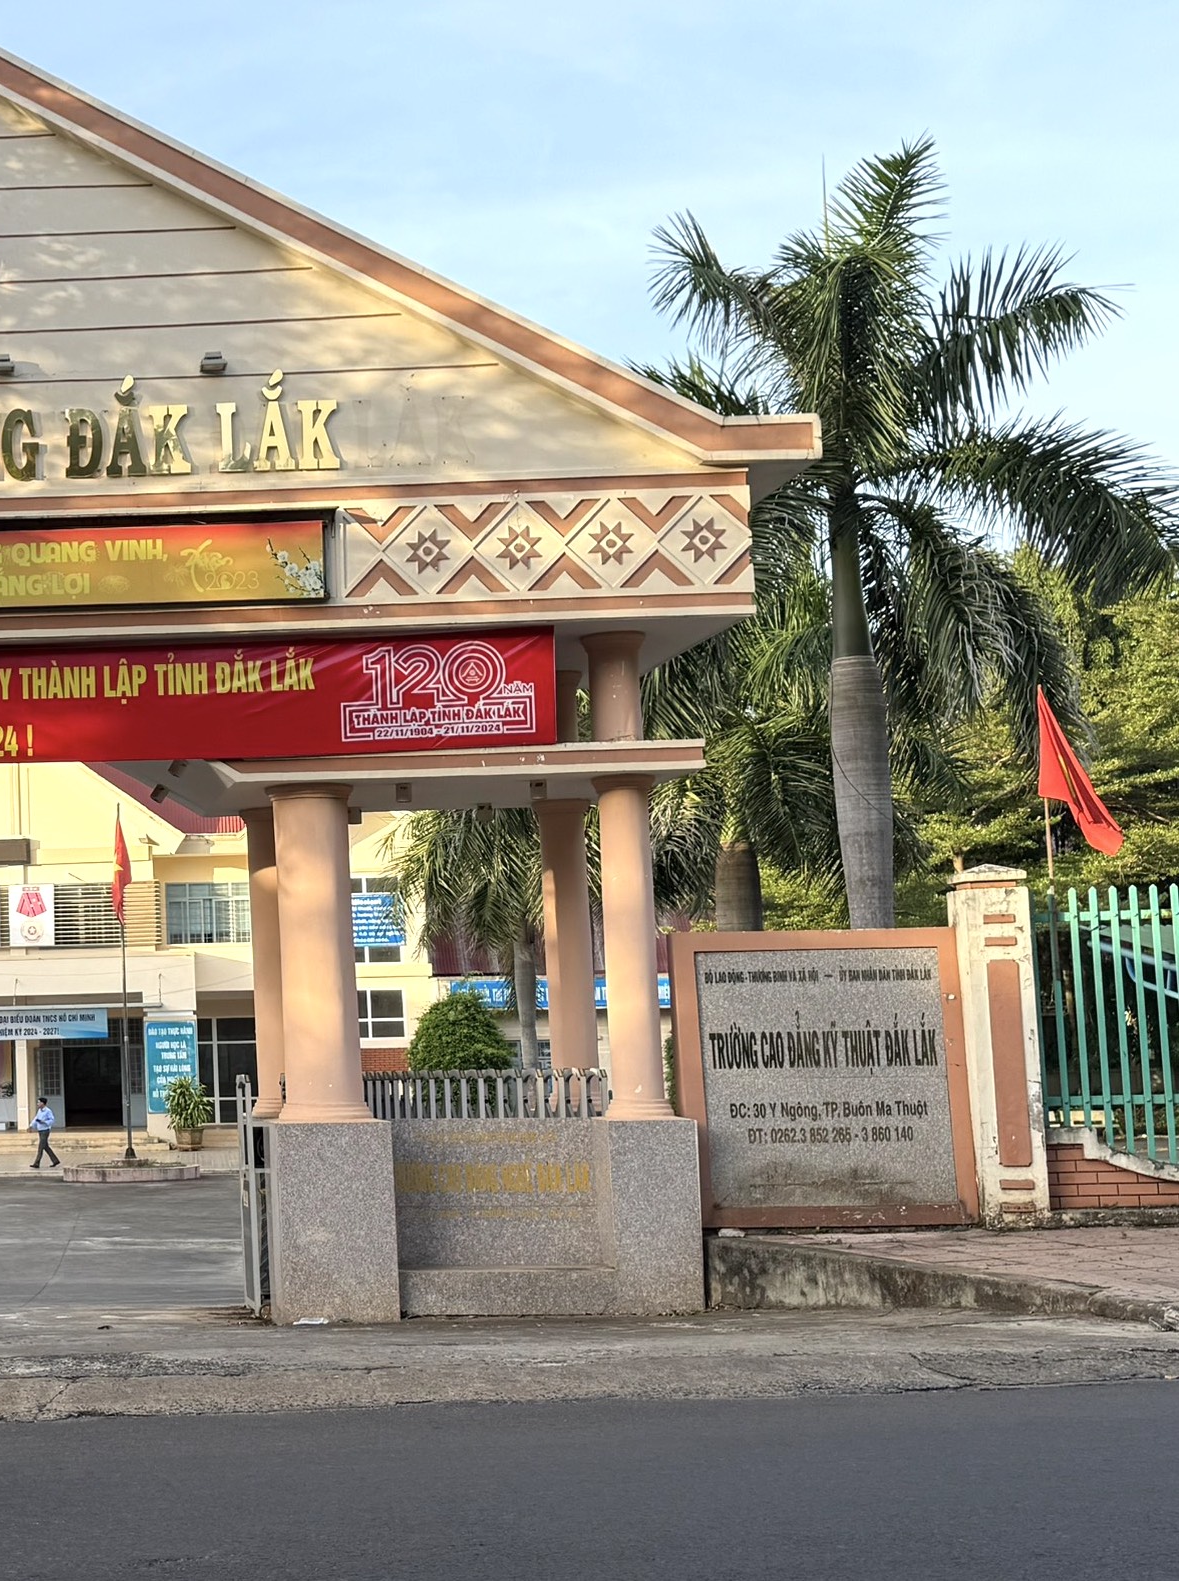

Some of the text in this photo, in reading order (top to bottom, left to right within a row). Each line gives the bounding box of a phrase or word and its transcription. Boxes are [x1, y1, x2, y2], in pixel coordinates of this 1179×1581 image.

[64, 374, 193, 478] ĐẮK
[215, 368, 341, 473] LẮK
[9, 542, 97, 566] QUANG
[104, 538, 168, 563] VINH,
[52, 573, 91, 600] LỢI
[204, 570, 260, 591] 2023
[19, 660, 96, 699] THÀNH
[103, 658, 148, 705] LẬP
[153, 652, 207, 696] TỈNH
[215, 648, 263, 695] ĐẮK
[271, 647, 316, 691] LẮK
[362, 640, 507, 708] 120
[502, 680, 535, 696] NĂM
[354, 701, 524, 728] THÀNH LẬP TỈNH ĐẮK LẮK
[26, 724, 34, 757] !
[376, 724, 501, 738] 22/11/1904 21/11/2024
[23, 1028, 38, 1036] 2024
[709, 1010, 938, 1075] TRƯỜNG CAO ĐẲNG KỸ THUẬT ĐẮK LẮK
[729, 1103, 751, 1119] ĐC:
[753, 1103, 766, 1119] 30
[769, 1102, 777, 1118] Y
[843, 1100, 873, 1117] Buôn
[876, 1101, 892, 1116] Ma
[895, 1101, 929, 1119] Thuột
[748, 1128, 768, 1144] ĐT:
[810, 1128, 828, 1144] 852
[862, 1127, 869, 1142] 3
[872, 1126, 891, 1142] 860
[895, 1126, 913, 1142] 140
